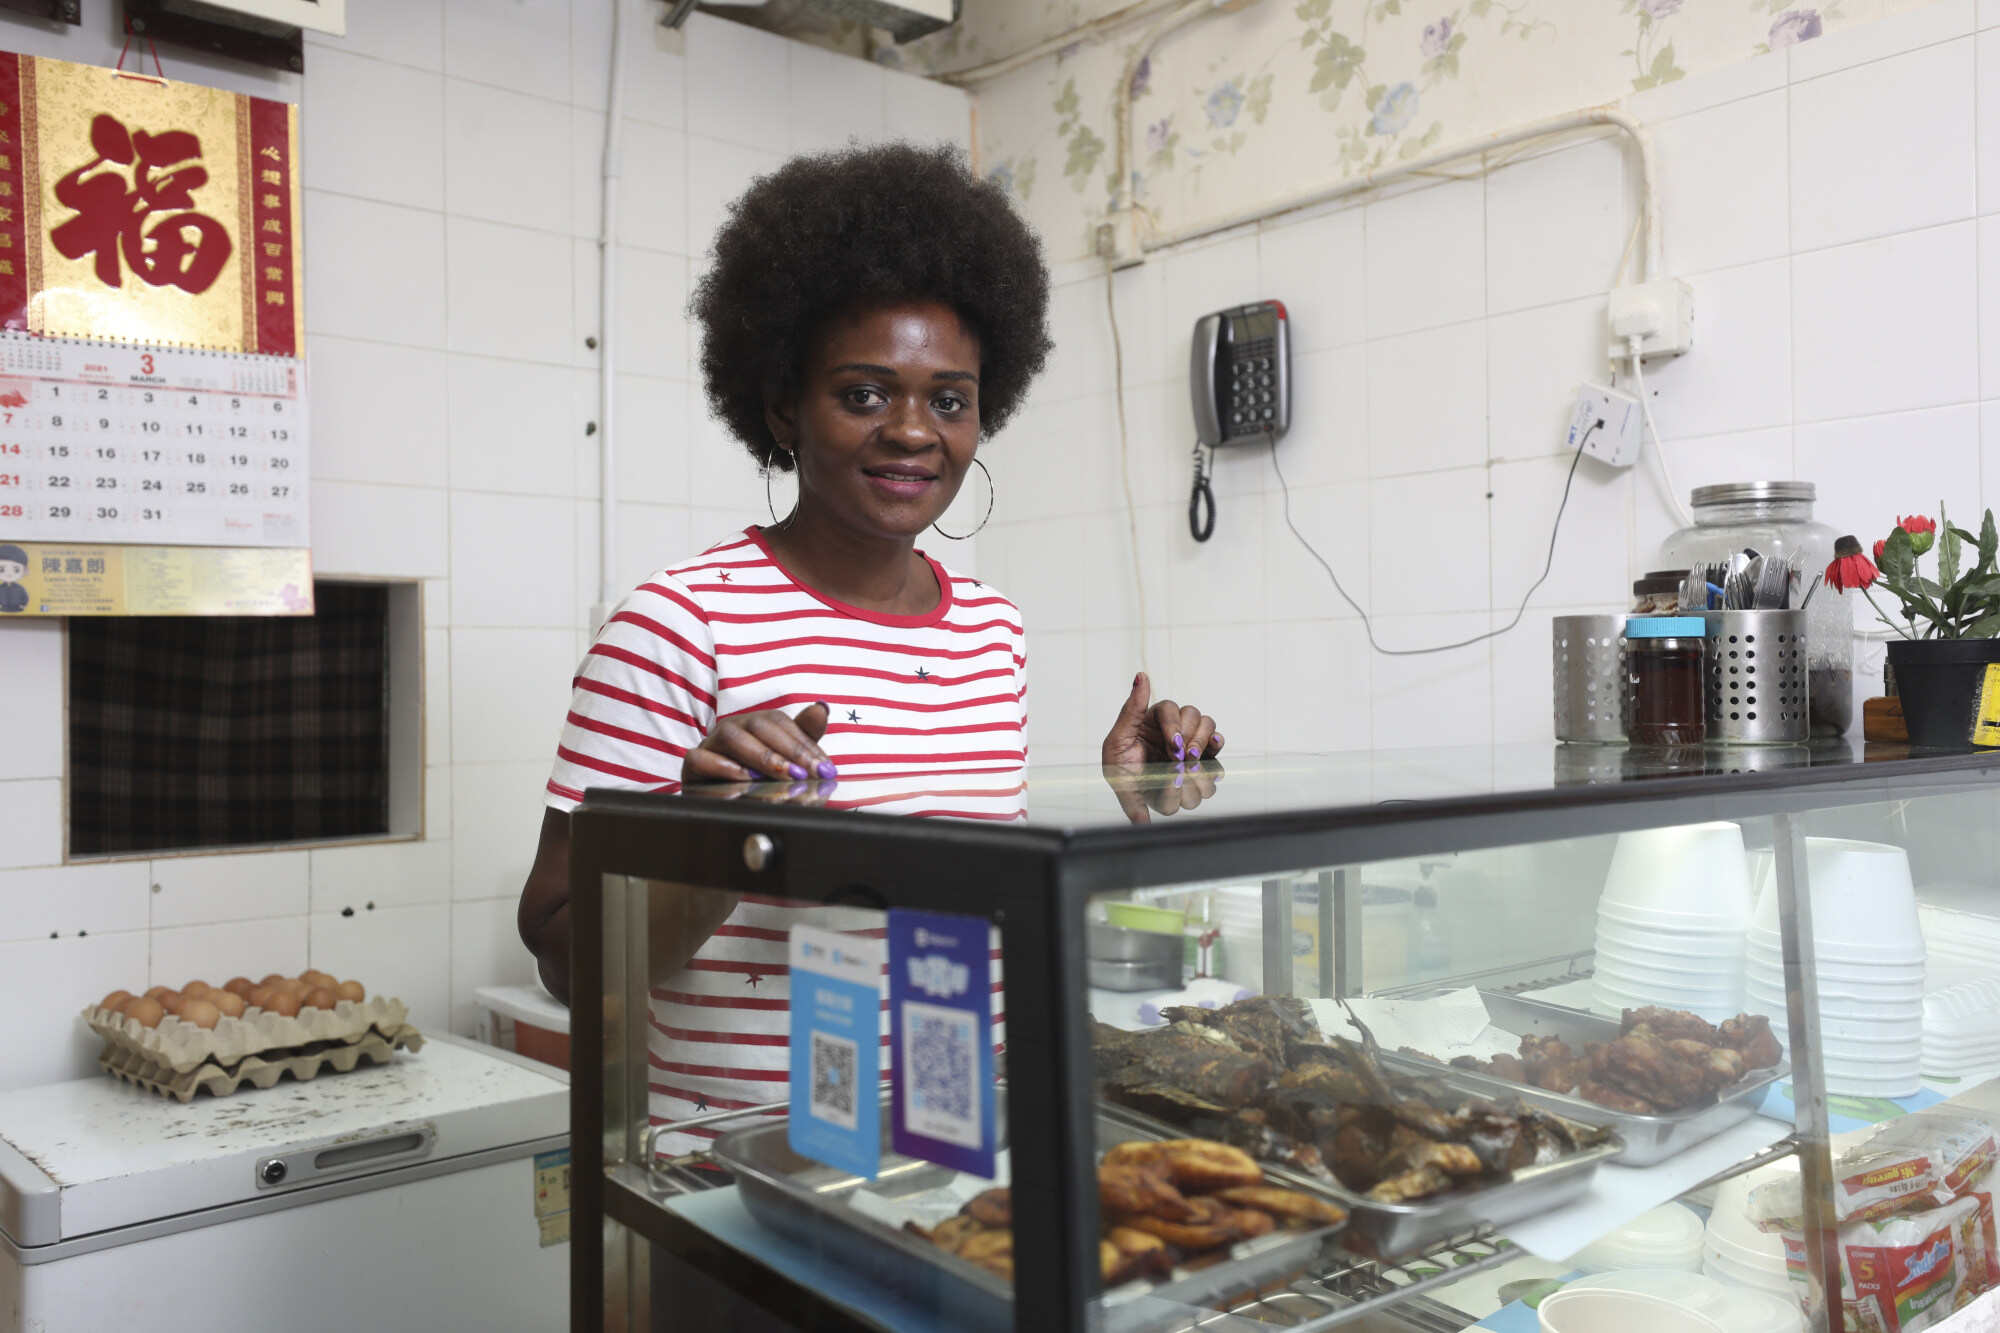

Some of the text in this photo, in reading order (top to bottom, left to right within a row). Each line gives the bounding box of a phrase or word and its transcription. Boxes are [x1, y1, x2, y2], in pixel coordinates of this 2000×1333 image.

[50, 113, 233, 296] 福
[140, 353, 154, 375] 3
[130, 374, 167, 384] MARCH
[53, 387, 283, 412] 1 2 3 4 5 6
[3, 413, 288, 441] 7 8 9 10 11 12 13
[0, 444, 289, 470] 14 15 16 17 18 19 20
[0, 474, 289, 498] 21 22 23 24 25 26 27
[0, 505, 162, 521] 28 29 30 31
[1856, 1260, 1876, 1281] 5
